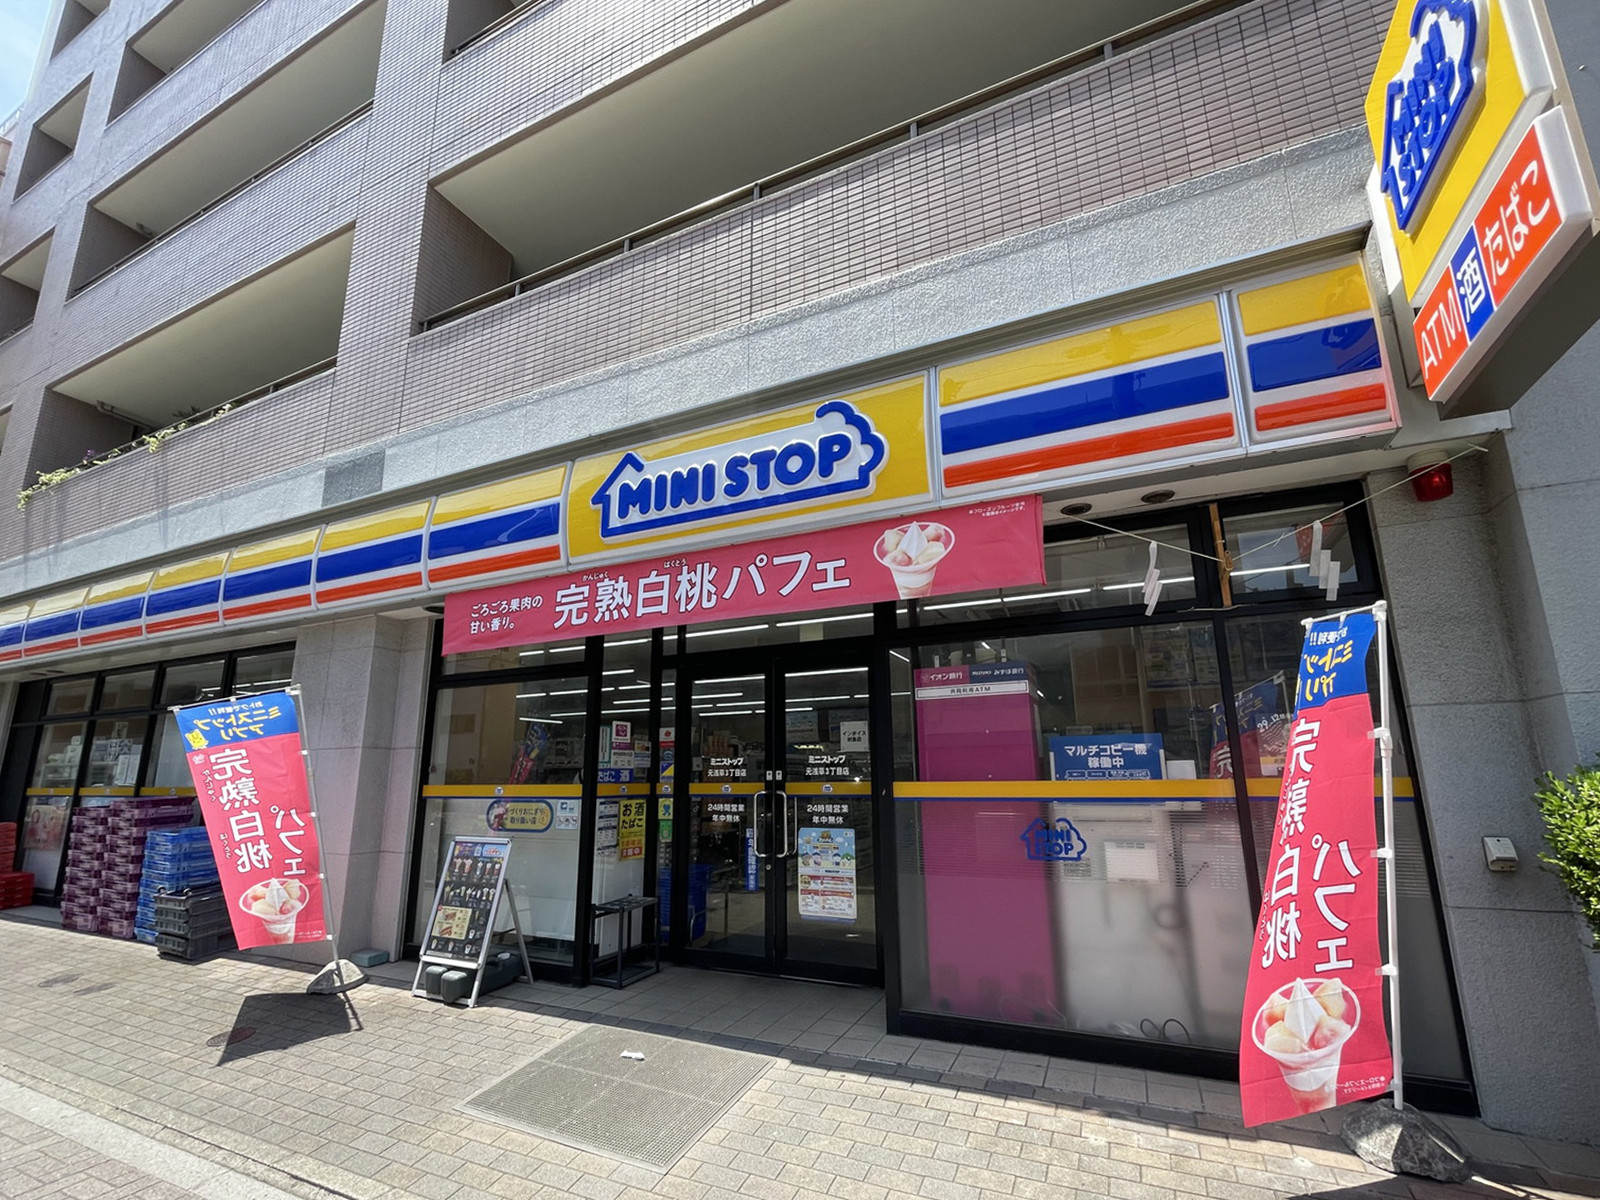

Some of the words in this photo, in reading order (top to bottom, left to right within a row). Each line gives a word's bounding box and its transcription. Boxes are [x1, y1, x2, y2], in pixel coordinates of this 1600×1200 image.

[1398, 58, 1455, 197] STOP
[1483, 159, 1550, 287] たばこ
[1458, 247, 1487, 324] 酒
[1420, 289, 1463, 380] ATM
[617, 459, 716, 520] MINI
[722, 433, 853, 498] STOP
[663, 558, 687, 569] はくとう
[553, 550, 851, 631] 完熟白桃パフェ
[471, 595, 543, 617] ごろごろ果肉の
[470, 617, 515, 635] 甘い香り。
[1064, 743, 1147, 756] マルチコピー機
[710, 757, 744, 766] ミニストップ
[808, 755, 846, 764] ミニストップ
[1087, 756, 1124, 768] 稼働中
[619, 769, 630, 782] 酒
[622, 802, 645, 817] お酒
[707, 803, 745, 812] 24時間営業
[806, 804, 849, 813] 24時間営業
[621, 817, 644, 829] たばこ
[712, 814, 740, 823] 年中無休
[812, 815, 844, 824] 年中無休
[1035, 829, 1072, 843] MINI
[1035, 842, 1074, 855] STOP
